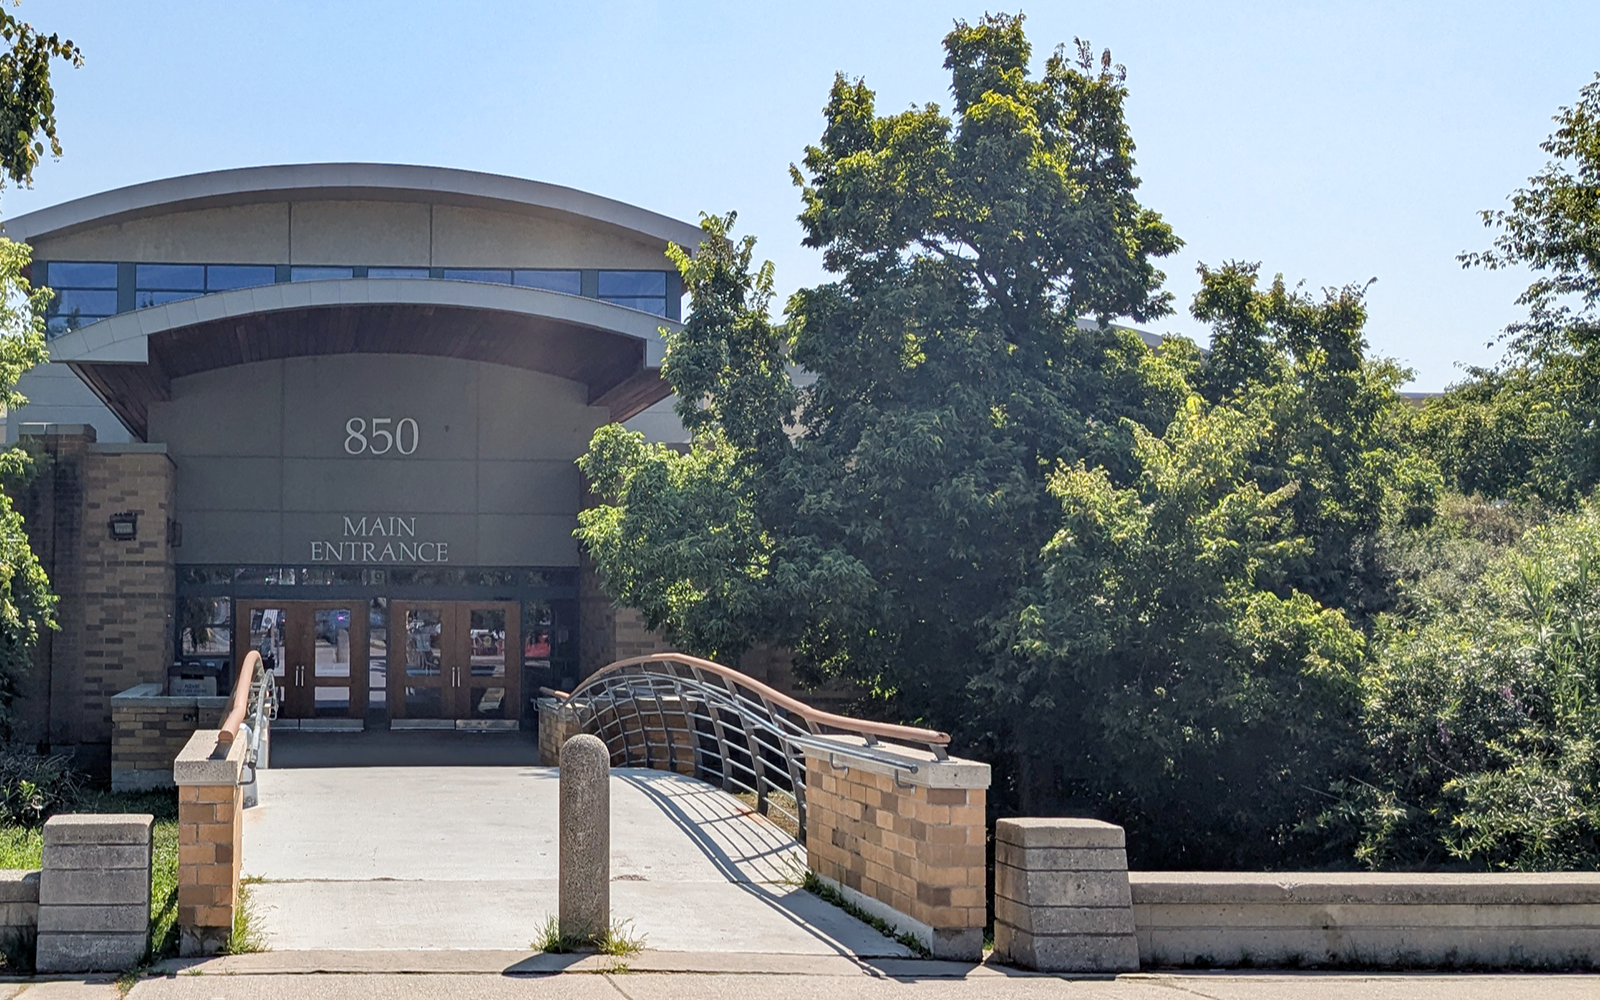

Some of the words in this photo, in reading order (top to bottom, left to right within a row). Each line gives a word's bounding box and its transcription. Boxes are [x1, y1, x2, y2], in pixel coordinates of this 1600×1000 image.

[344, 417, 419, 455] 850
[343, 516, 416, 537] MAIN
[310, 541, 449, 562] ENTRANCE
